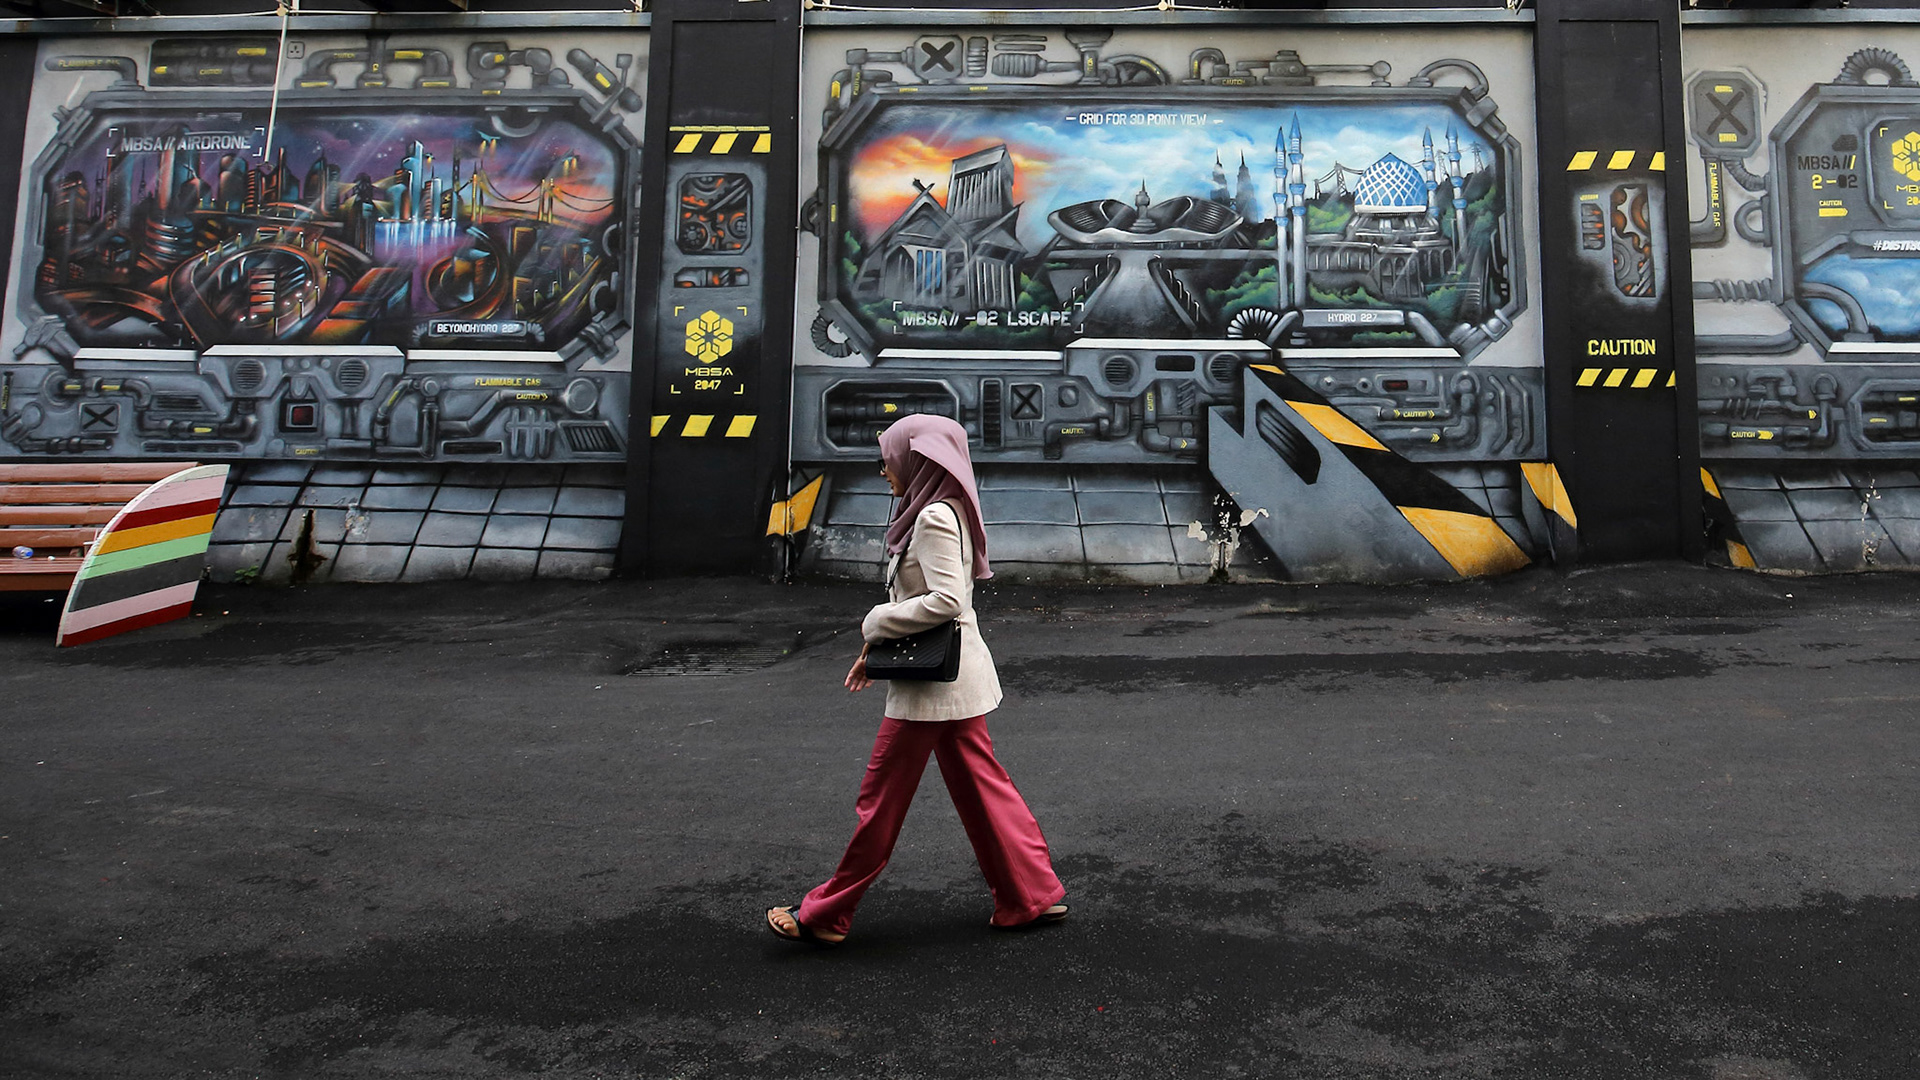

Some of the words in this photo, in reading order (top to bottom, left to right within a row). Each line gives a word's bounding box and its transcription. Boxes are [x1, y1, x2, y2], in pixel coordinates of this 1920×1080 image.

[1079, 113, 1103, 125] GRID
[1105, 113, 1127, 125] FOR
[1129, 113, 1145, 125] 3D
[1147, 113, 1177, 126] POINT
[1179, 113, 1207, 126] VIEW
[176, 135, 252, 150] AIRDRONE
[1709, 162, 1720, 209] FLAMMABLE
[1713, 211, 1721, 229] GAS
[1007, 311, 1071, 327] LSCAPE
[1327, 313, 1356, 322] HYDRO
[1360, 313, 1377, 323] 227
[501, 323, 520, 333] 227
[1587, 339, 1656, 355] CAUTION
[685, 367, 734, 376] MBSA
[475, 377, 522, 386] FLAMMABLE
[525, 377, 541, 386] GAS
[694, 379, 721, 390] 2047
[1403, 410, 1428, 418] CAUTION
